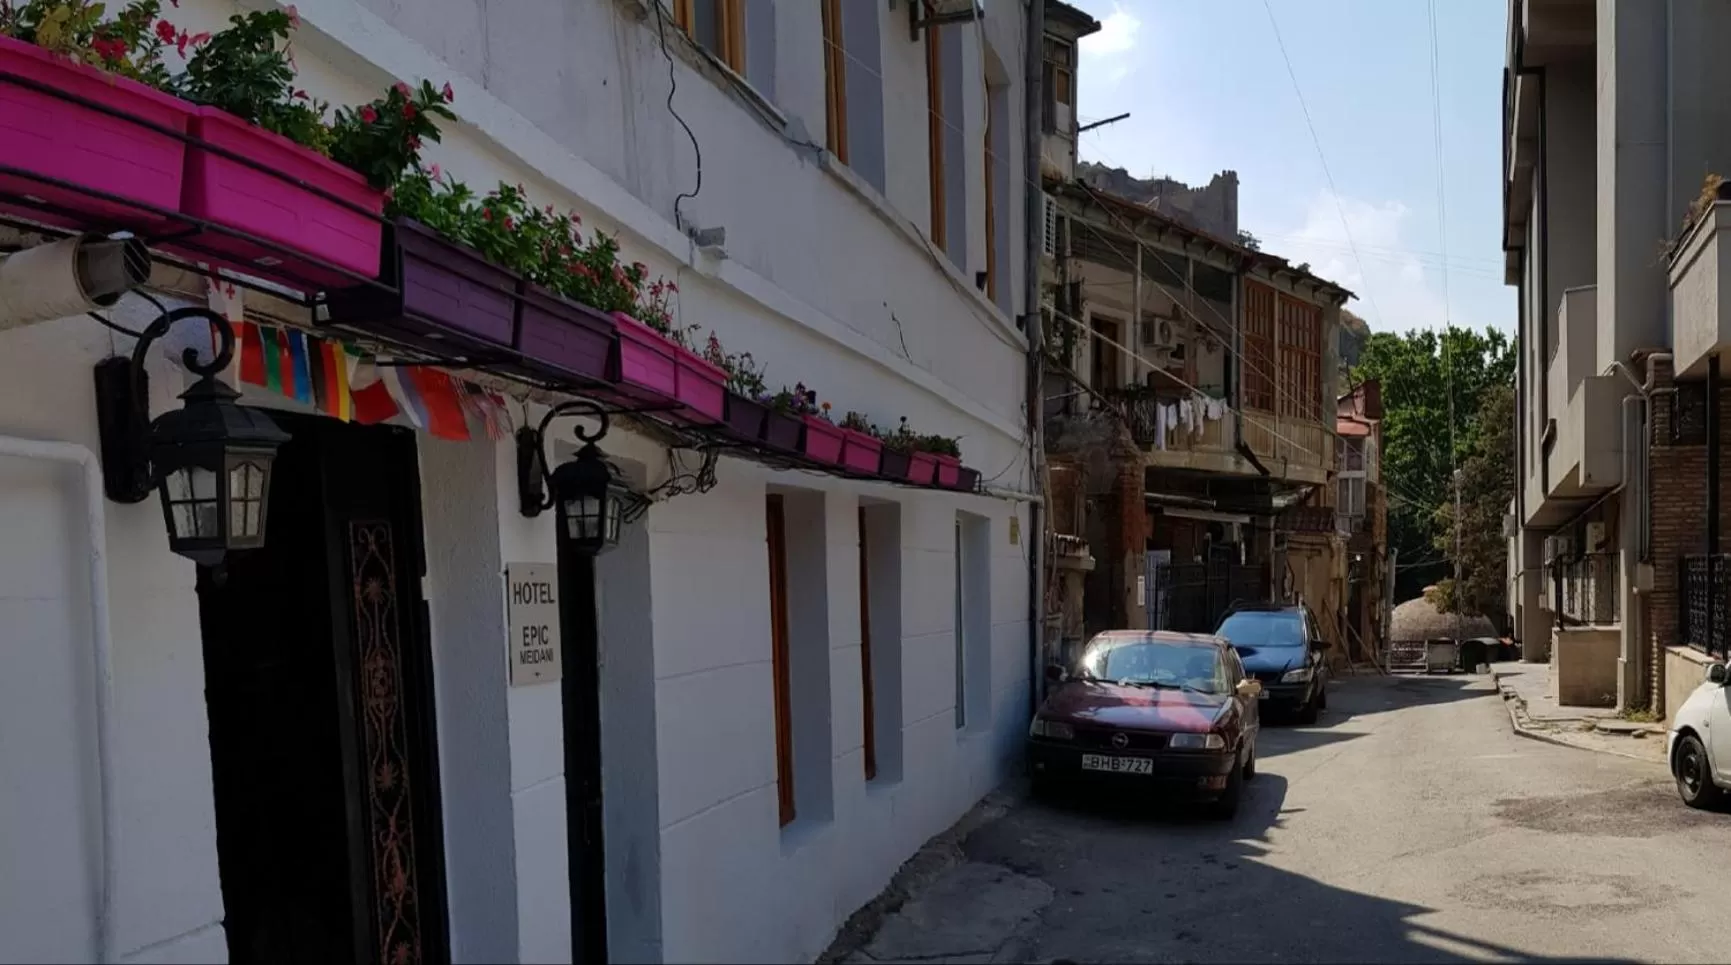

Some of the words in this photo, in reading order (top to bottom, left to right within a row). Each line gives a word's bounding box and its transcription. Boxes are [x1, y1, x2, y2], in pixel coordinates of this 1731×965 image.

[513, 582, 555, 604] HOTEL
[523, 625, 549, 647] EPIC
[519, 648, 554, 665] MEIDANI
